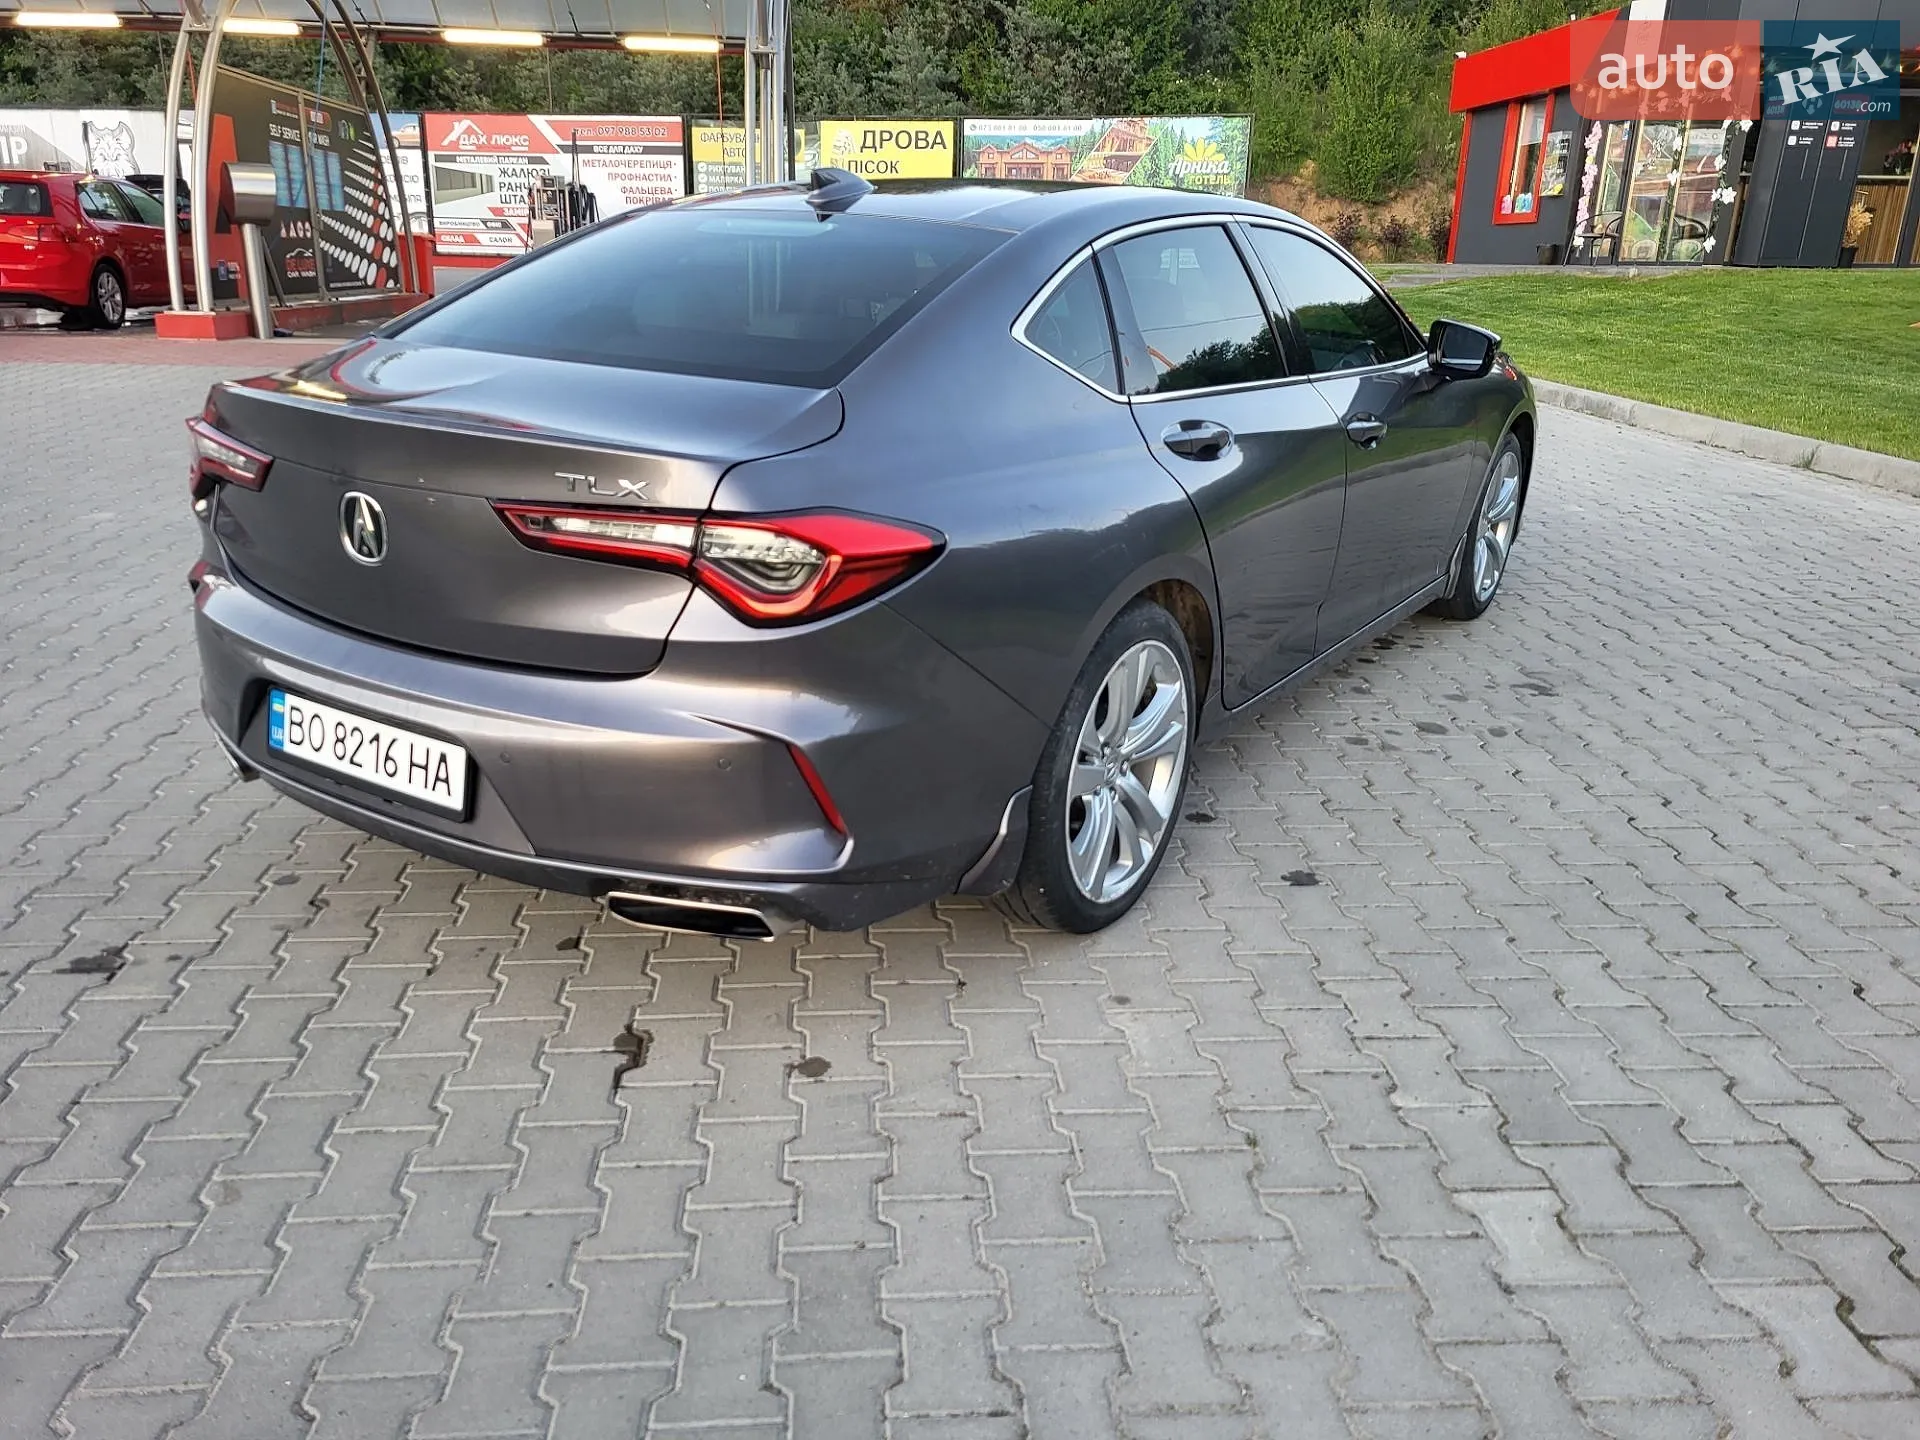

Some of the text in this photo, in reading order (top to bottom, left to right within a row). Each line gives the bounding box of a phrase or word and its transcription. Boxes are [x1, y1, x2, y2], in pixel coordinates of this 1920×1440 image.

[597, 127, 615, 136] 097
[619, 127, 636, 136] 988
[639, 127, 652, 136] 53
[654, 128, 667, 136] 02
[459, 134, 529, 146] ДАХ ЛЮКС
[860, 130, 947, 153] ДРОВА
[624, 146, 643, 154] ДАХУ
[582, 159, 672, 169] МЕТАЛОЧЕРЕПИЦЯ
[848, 160, 899, 174] ПІСОК
[608, 172, 672, 182] ПРОФНАСТИЛ
[621, 186, 672, 196] ФАЛЬЦЕВА
[554, 471, 649, 500] TLX
[289, 705, 452, 797] BO 8216 HA
